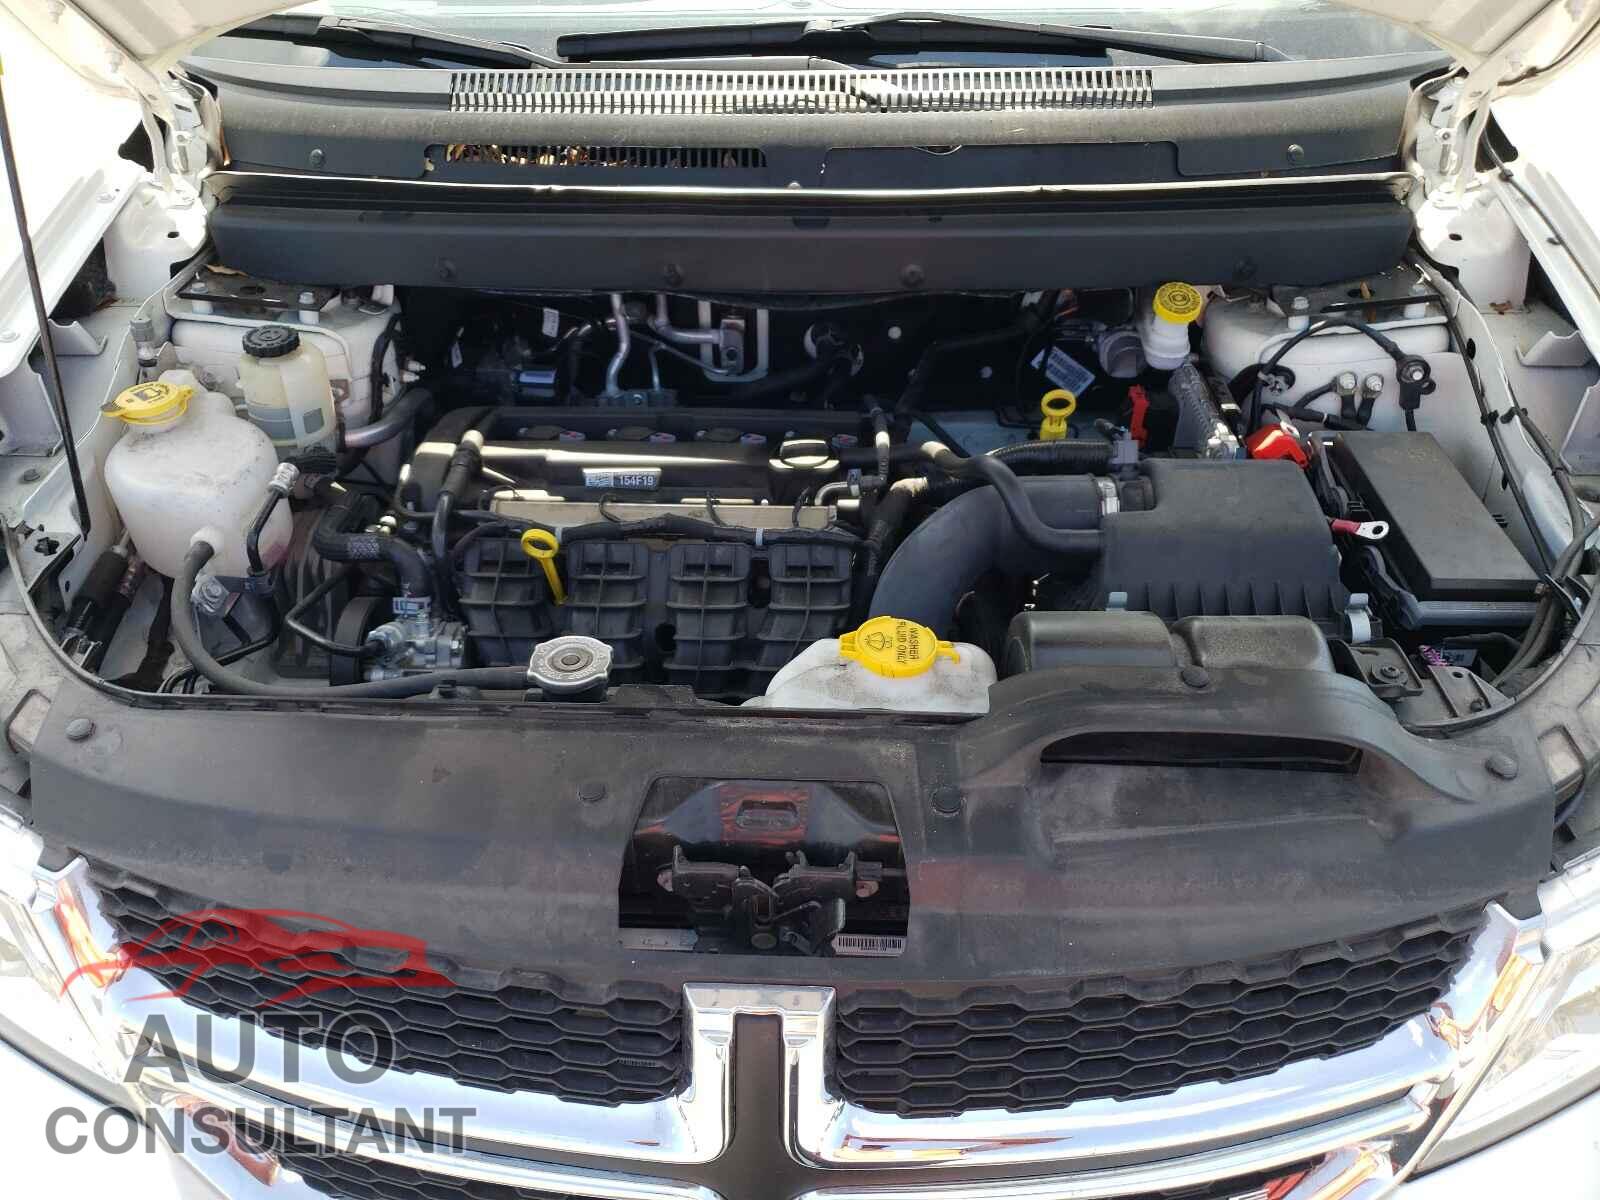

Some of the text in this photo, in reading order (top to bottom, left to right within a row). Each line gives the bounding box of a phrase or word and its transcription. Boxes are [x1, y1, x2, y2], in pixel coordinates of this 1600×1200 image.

[619, 475, 654, 486] 154F19
[896, 621, 908, 665] FLUID ONLY
[909, 627, 920, 660] WASHER
